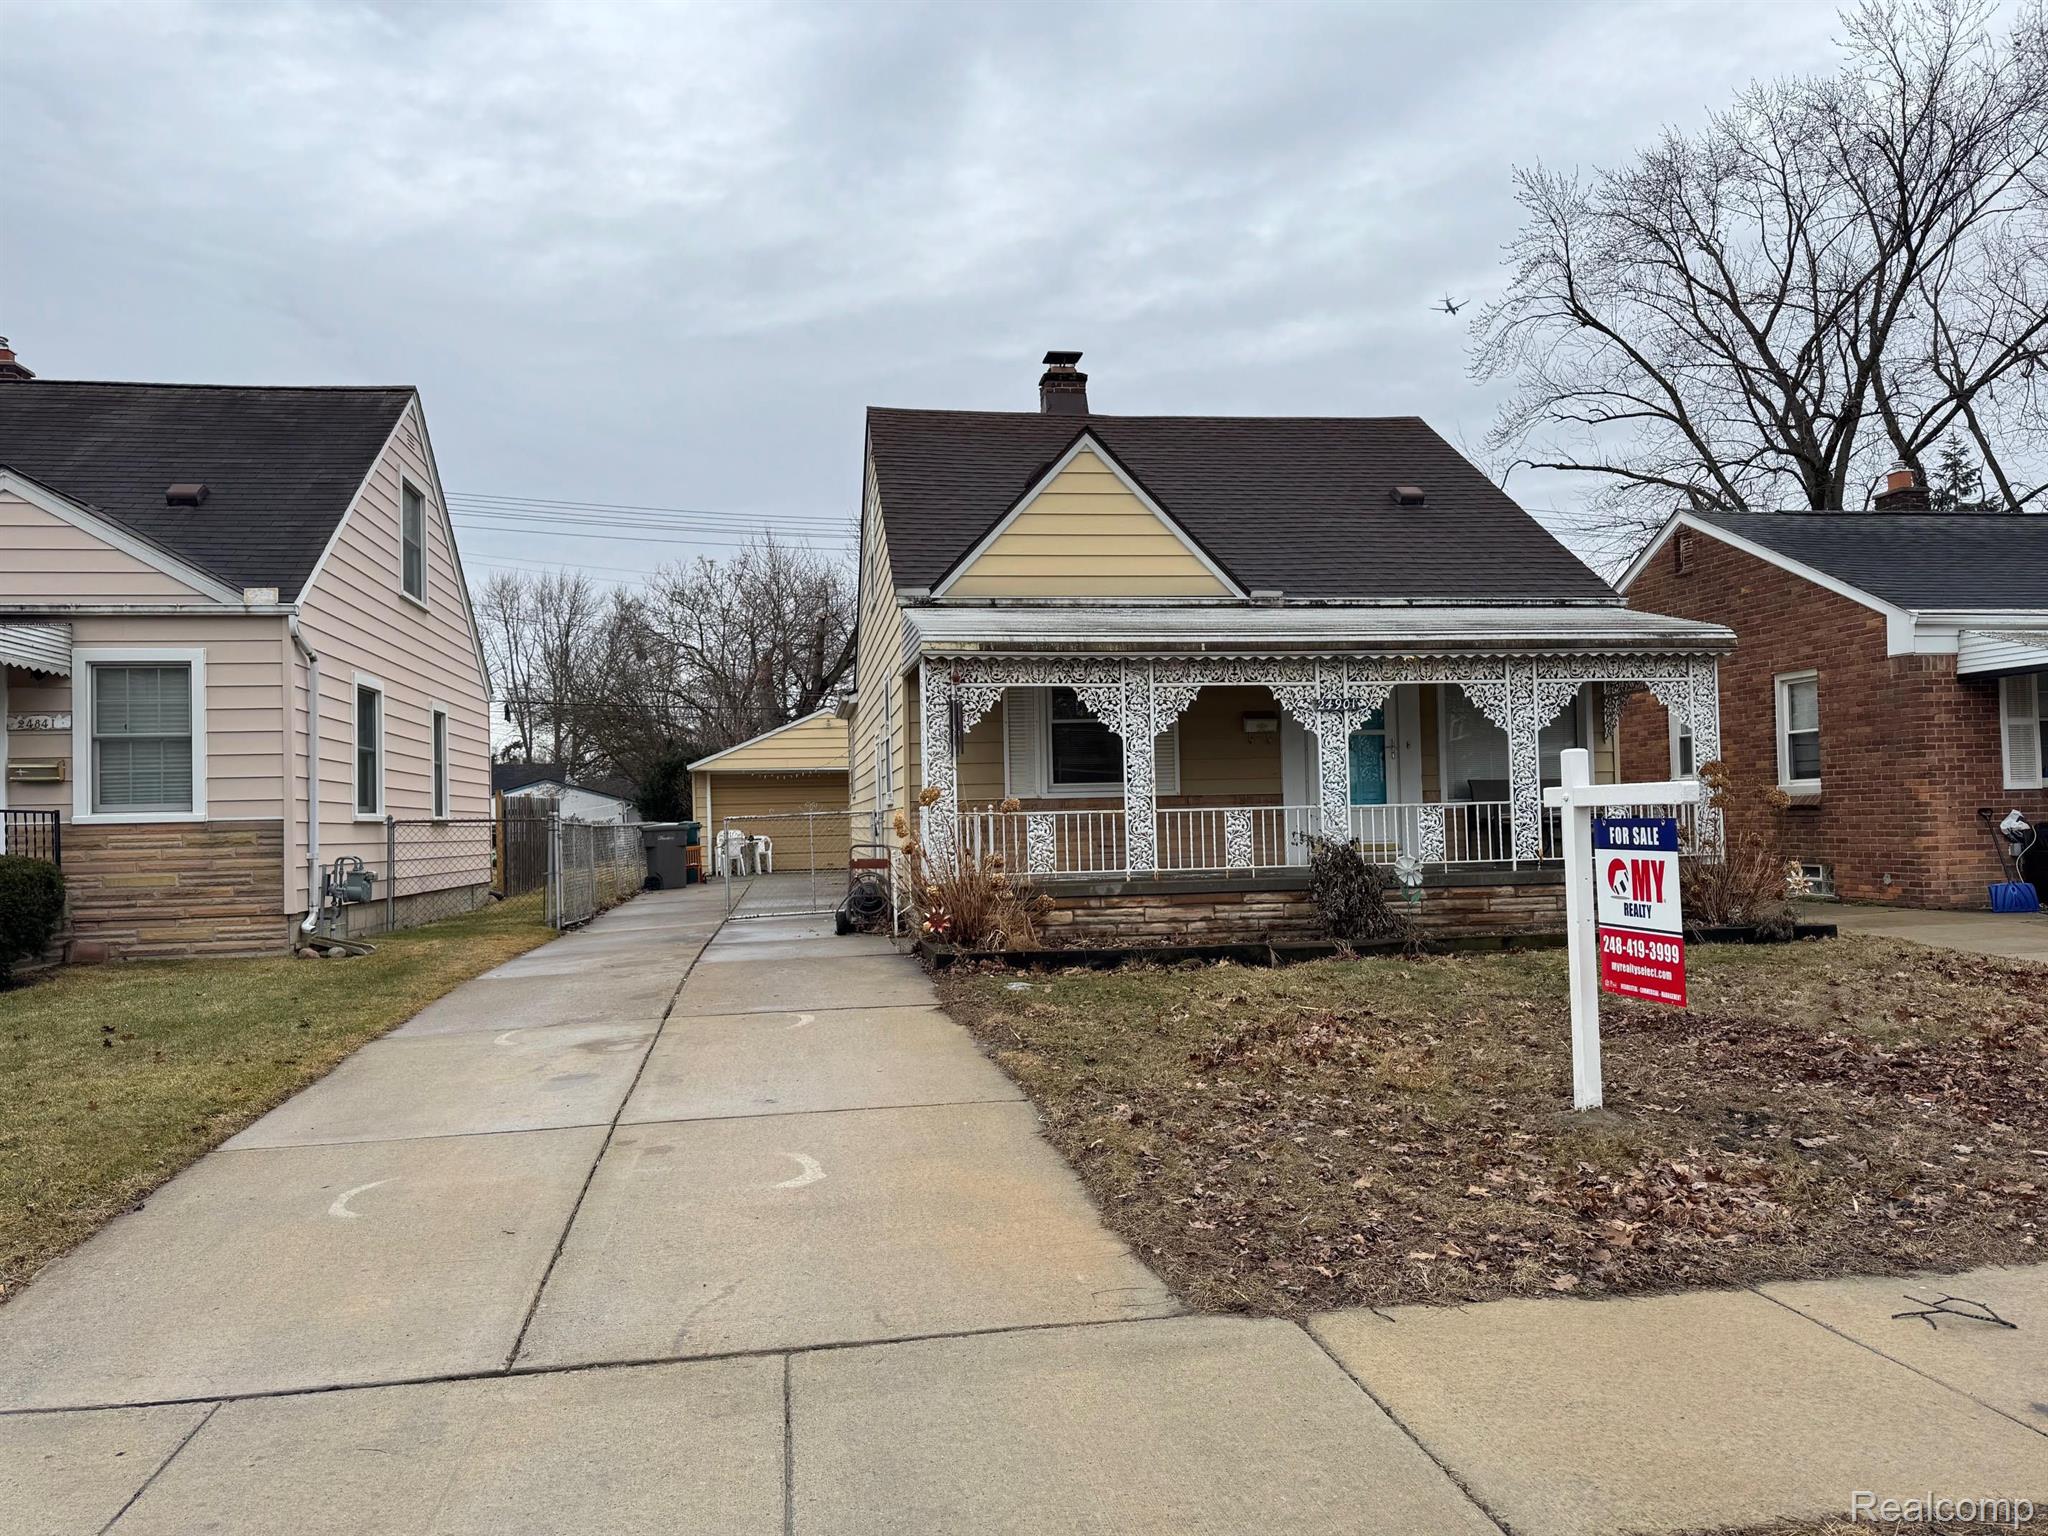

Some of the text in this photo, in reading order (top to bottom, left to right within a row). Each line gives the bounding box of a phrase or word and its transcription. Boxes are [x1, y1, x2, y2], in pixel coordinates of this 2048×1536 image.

[1317, 698, 1356, 710] 24901
[17, 718, 56, 729] 24841
[1609, 826, 1660, 845] FOR SALE
[1630, 858, 1666, 904] MY
[1623, 902, 1652, 919] REALTY
[1603, 935, 1680, 964] 248-419-3999
[1611, 961, 1673, 981] myrealtyselect.com
